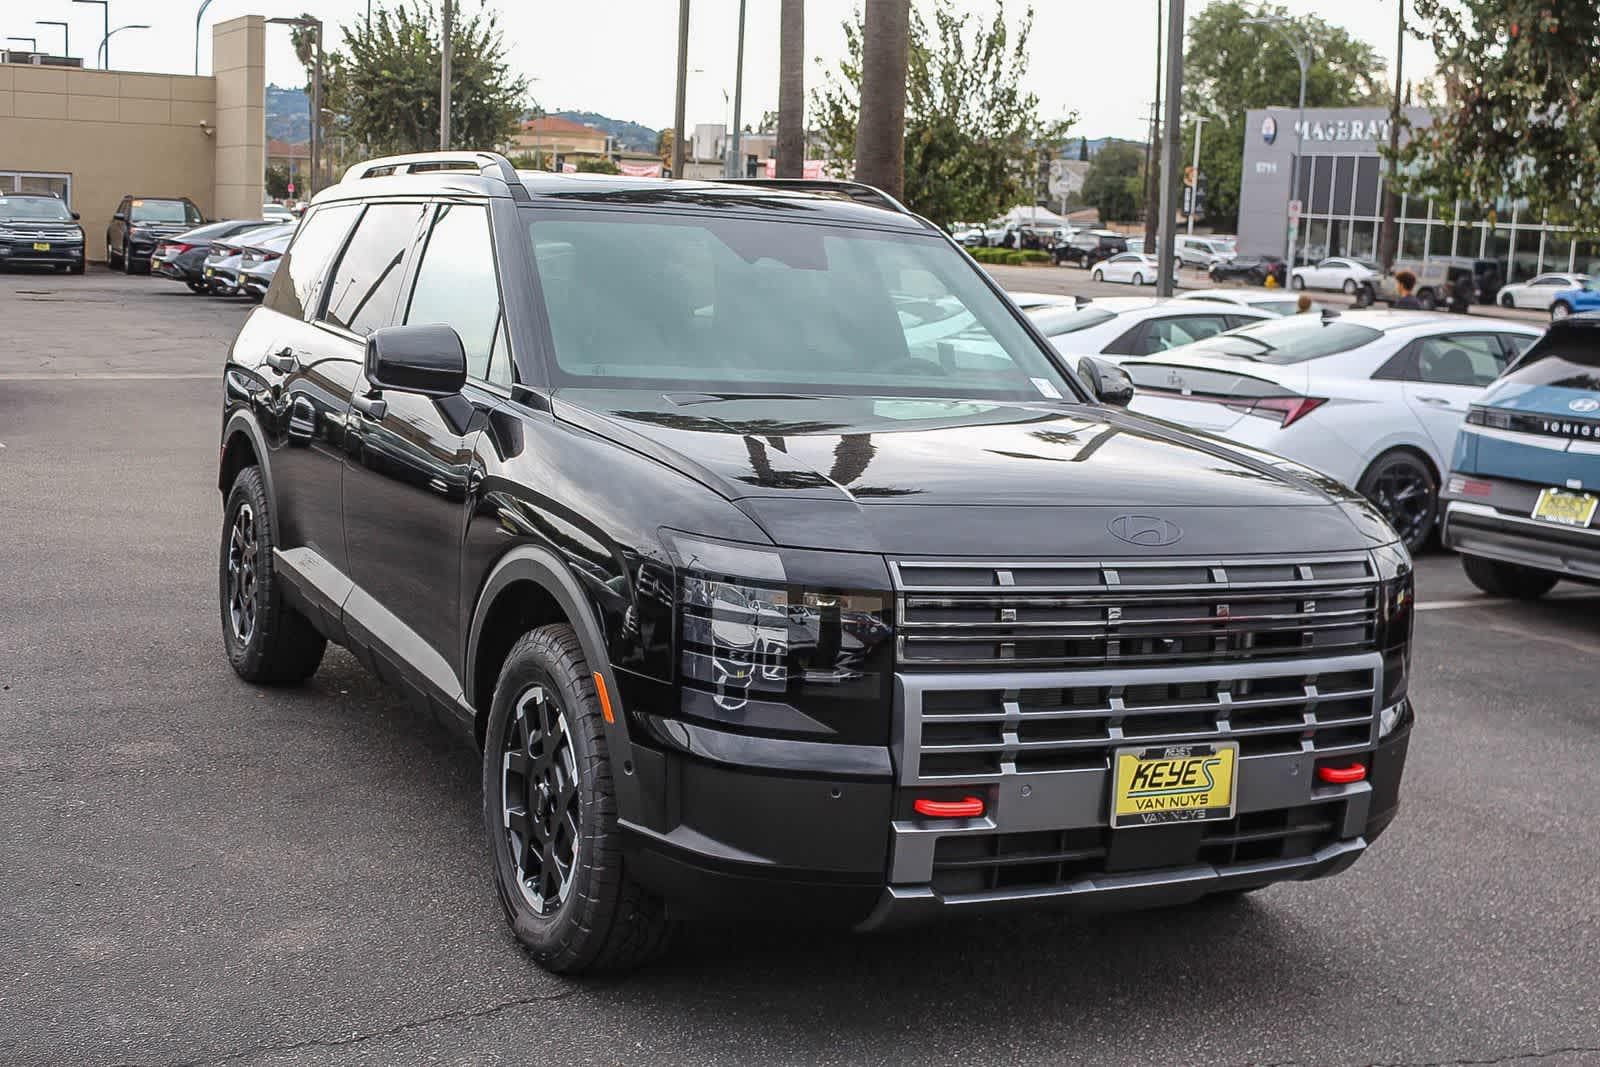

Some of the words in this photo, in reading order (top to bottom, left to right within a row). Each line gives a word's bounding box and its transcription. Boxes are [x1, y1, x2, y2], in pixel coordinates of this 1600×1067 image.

[1294, 119, 1394, 141] MASERAT
[1129, 758, 1221, 792] KEYES
[1135, 797, 1165, 810] VAN
[1169, 794, 1209, 806] NUYS
[1141, 811, 1168, 824] VAN
[1171, 809, 1206, 821] NUYS
